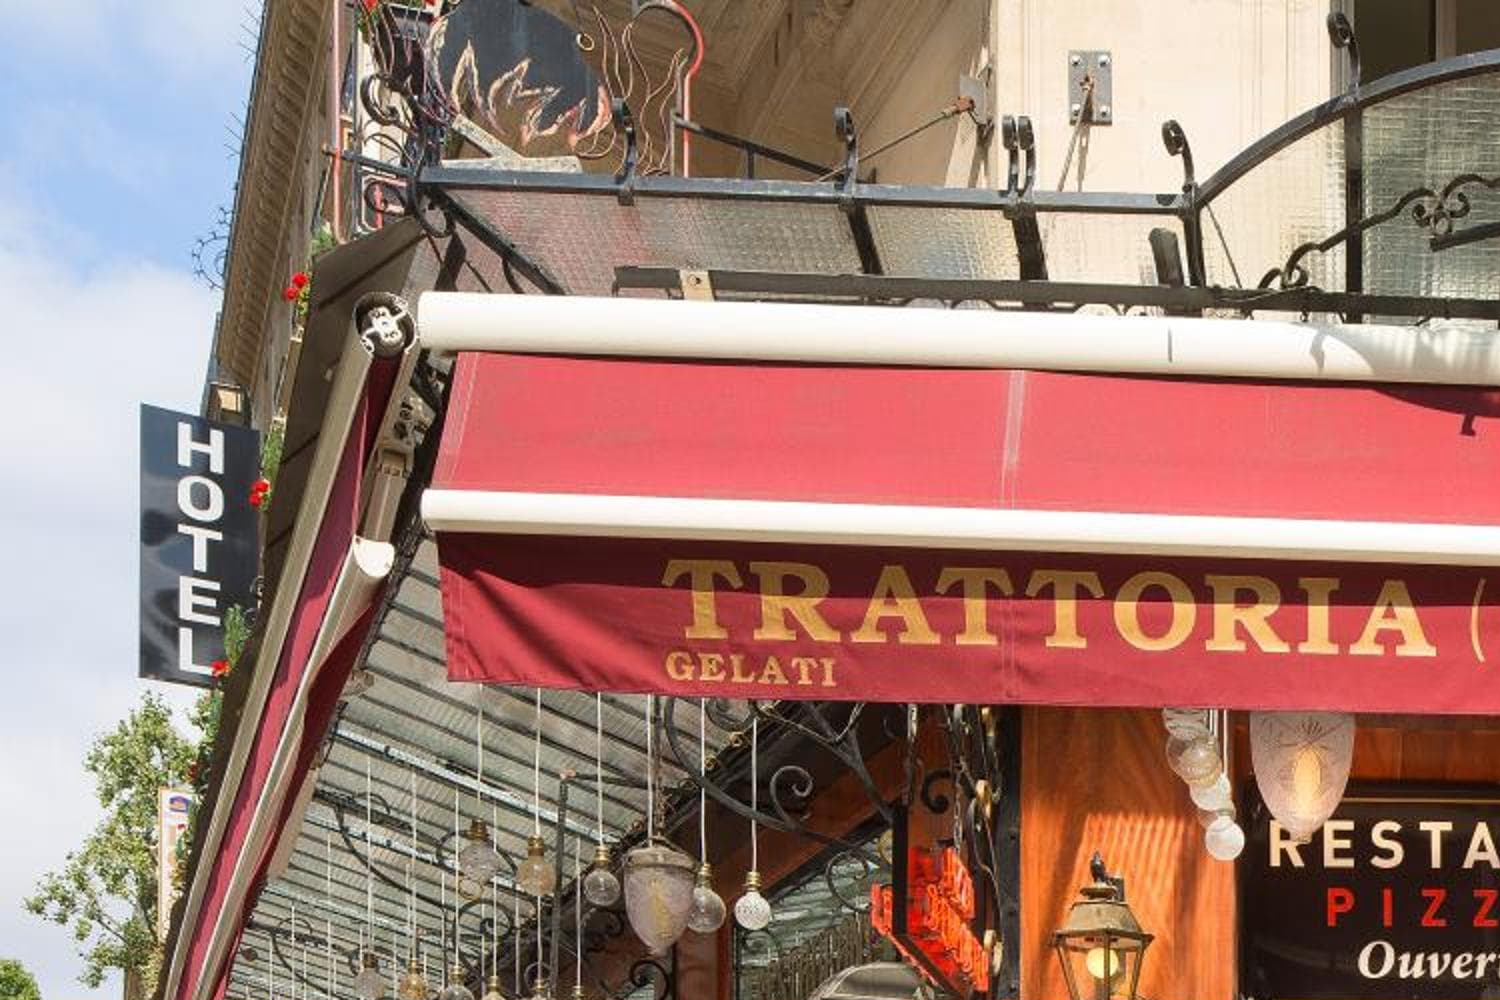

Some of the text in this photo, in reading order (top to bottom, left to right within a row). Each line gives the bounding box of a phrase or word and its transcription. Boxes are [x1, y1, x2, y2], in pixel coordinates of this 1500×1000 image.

[177, 421, 225, 676] HOTEL
[662, 558, 1437, 658] TRATTORIA
[665, 651, 837, 688] GELATI
